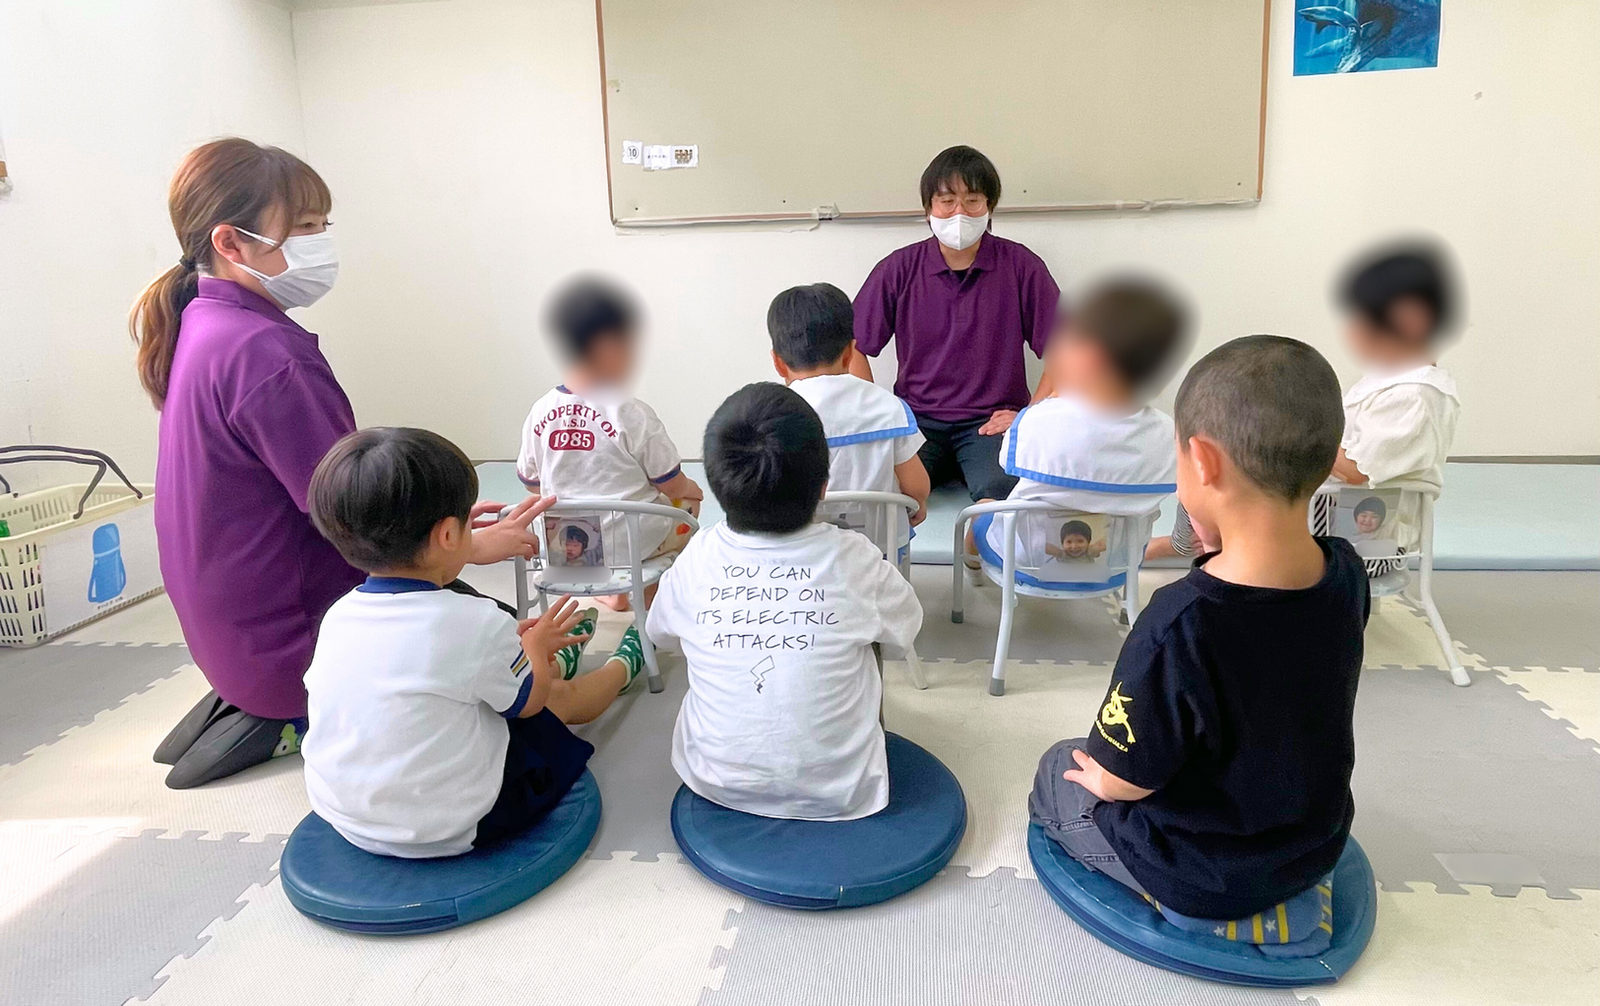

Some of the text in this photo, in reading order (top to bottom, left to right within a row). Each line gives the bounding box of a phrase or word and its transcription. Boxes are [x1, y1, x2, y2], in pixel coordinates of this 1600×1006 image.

[533, 404, 618, 438] PROPERTY OF
[553, 432, 591, 448] 1985
[722, 565, 811, 581] YOU CAN
[710, 586, 825, 602] DEPEND ON
[696, 610, 839, 625] ITS ELECTRIC
[713, 633, 815, 650] ATTACKS!
